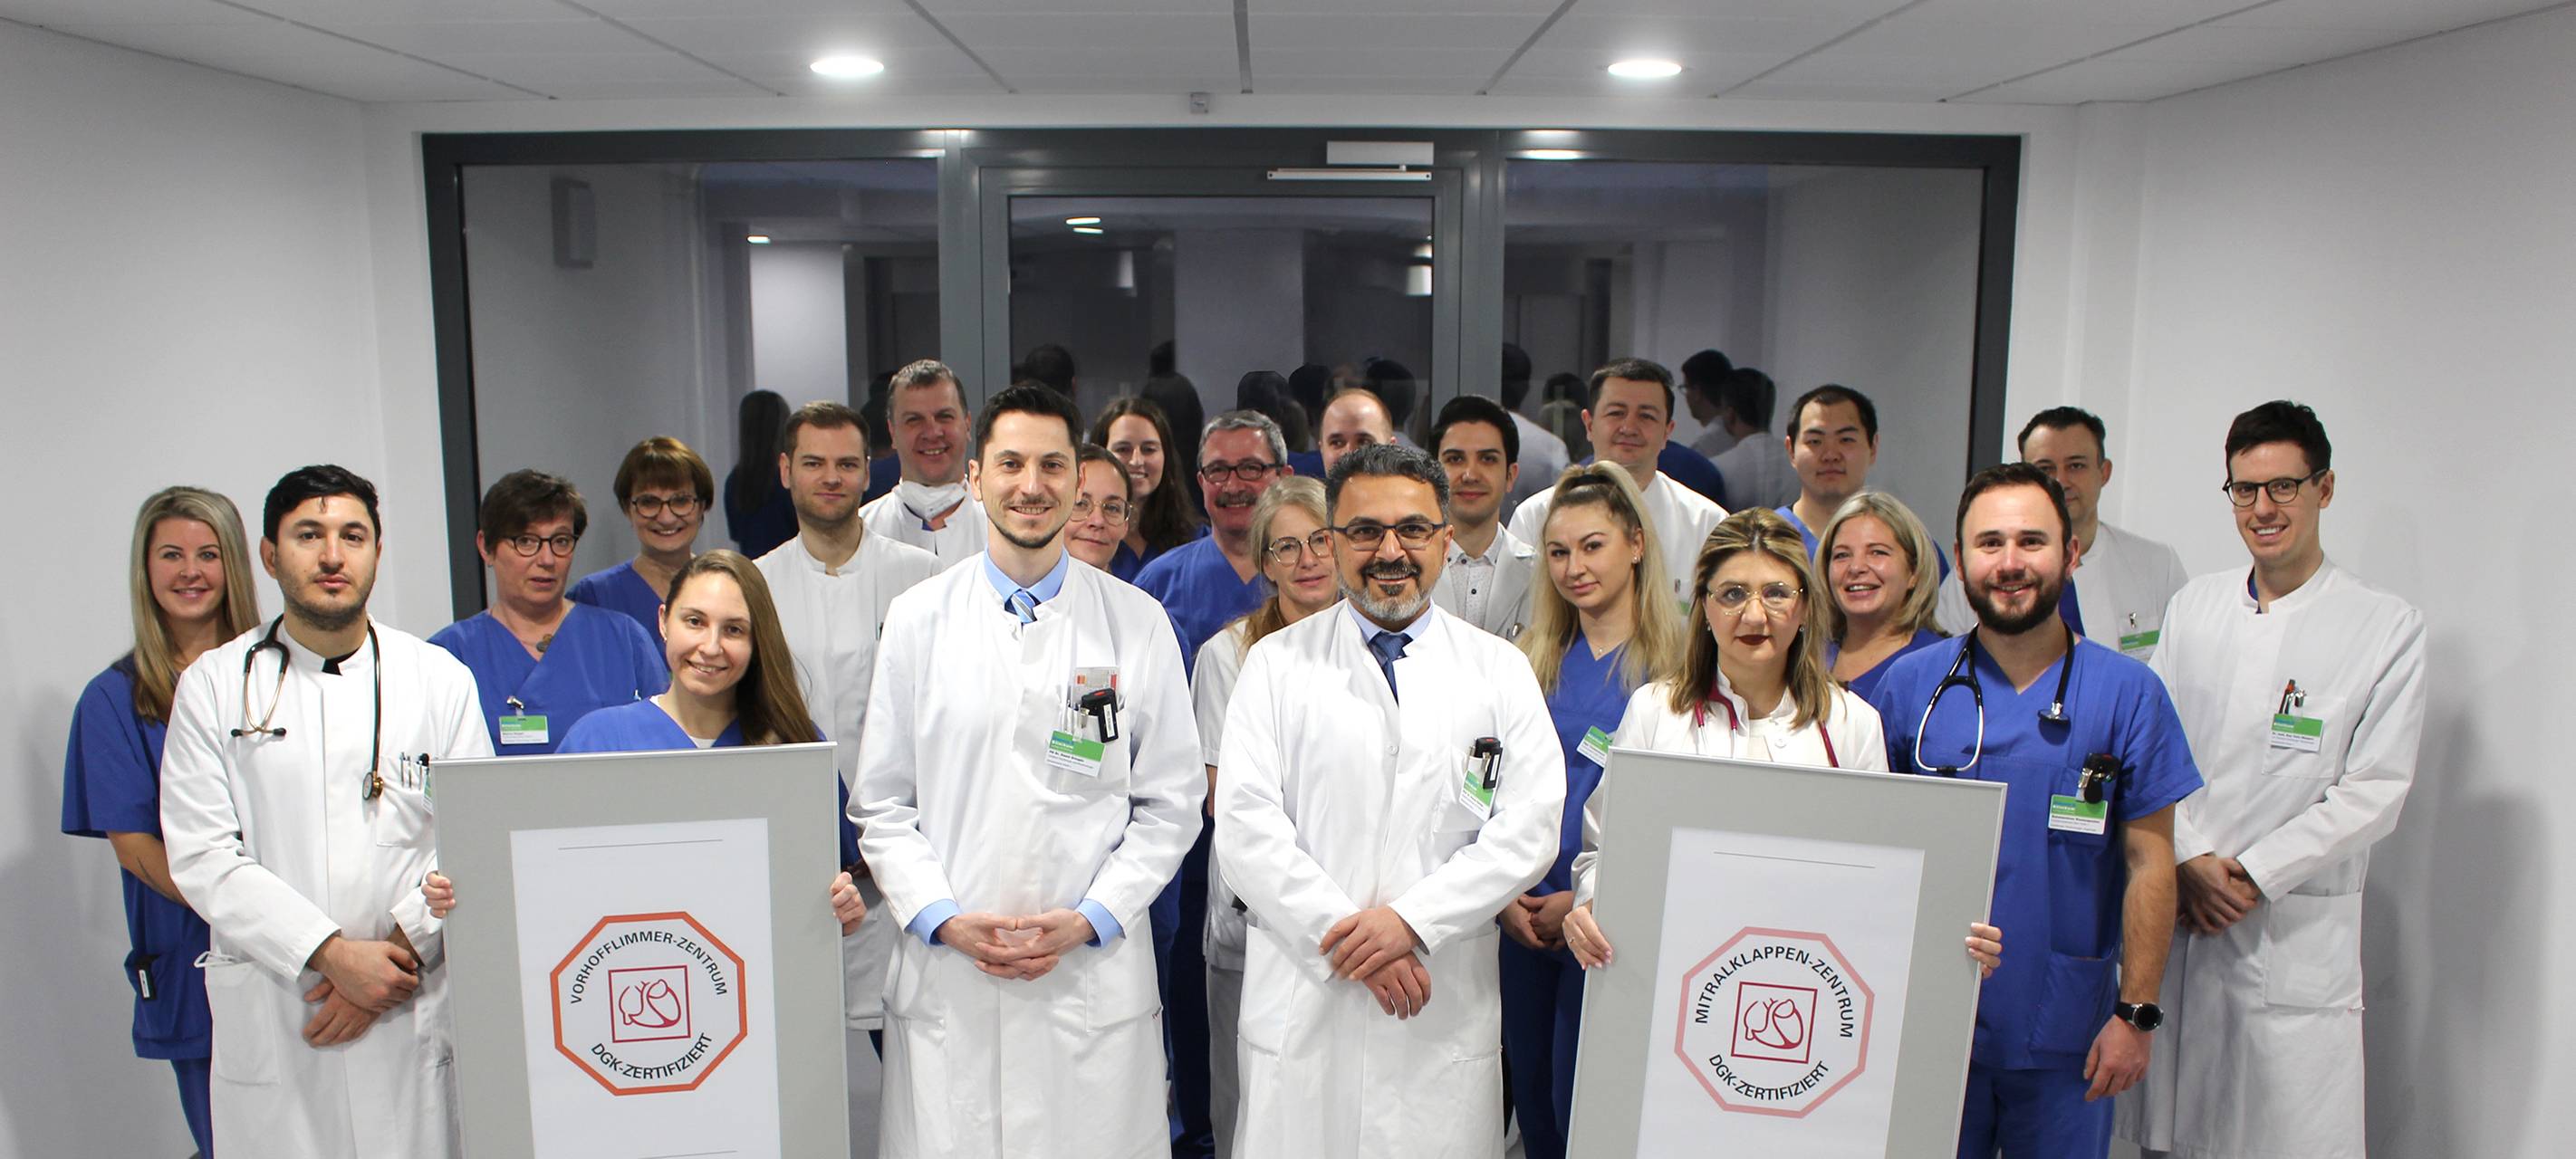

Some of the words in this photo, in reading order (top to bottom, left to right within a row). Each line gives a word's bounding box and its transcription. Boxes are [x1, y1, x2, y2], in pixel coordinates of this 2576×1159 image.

[570, 931, 728, 1005] VORHOFFLIMMER-ZENTRUM
[1694, 945, 1854, 1039] MITRALKLAPPEN-ZENTRUM
[591, 1032, 713, 1080] DGK-ZERTIFIZIERT
[1708, 1054, 1830, 1102] DGK-ZERTIFIZIERT
